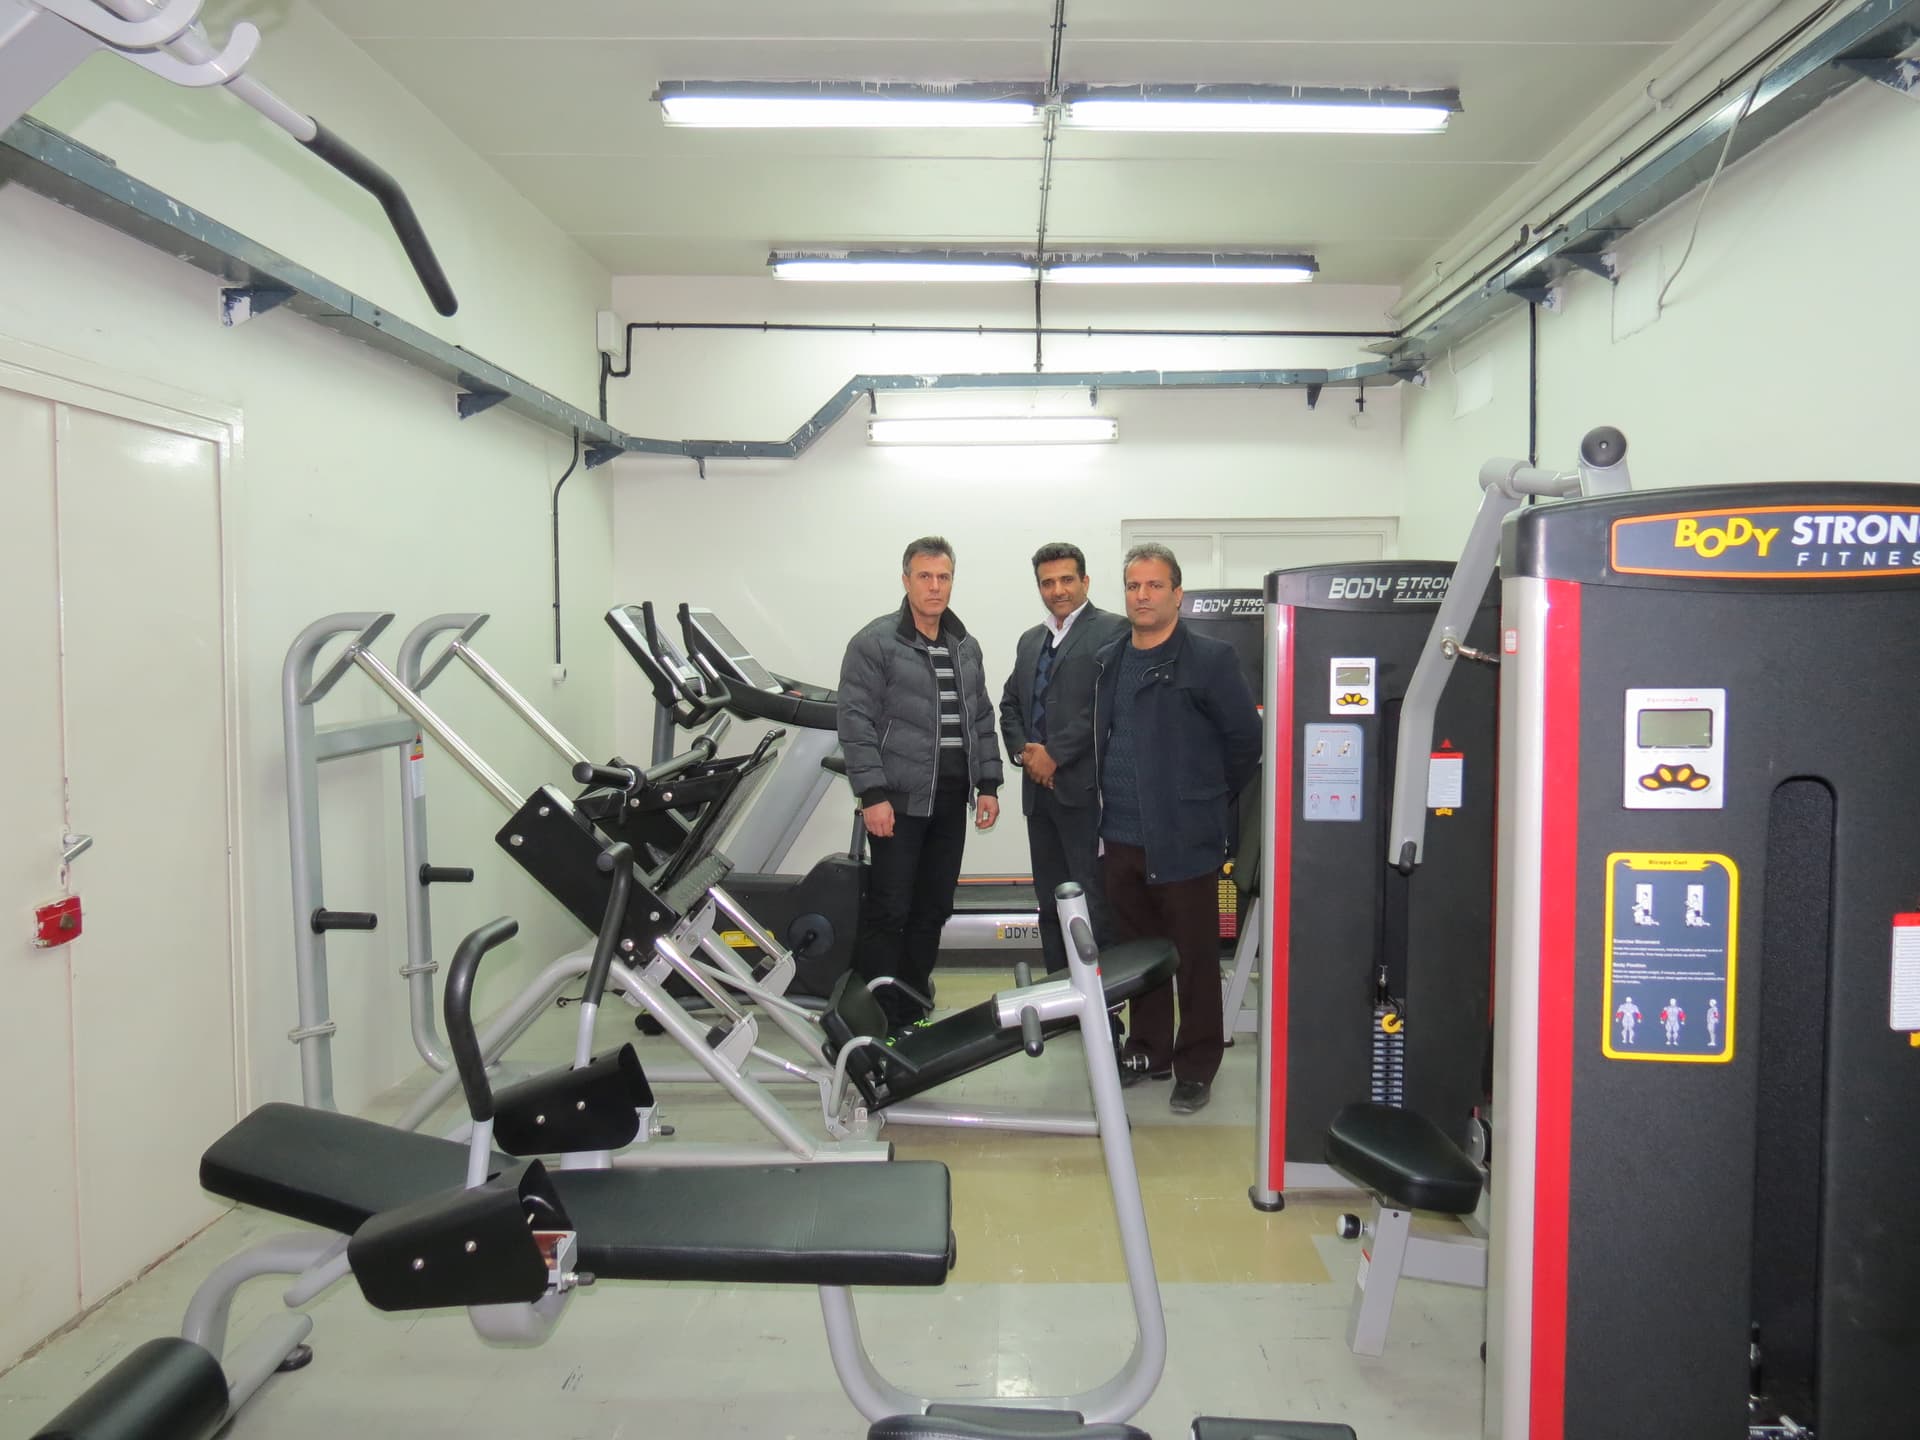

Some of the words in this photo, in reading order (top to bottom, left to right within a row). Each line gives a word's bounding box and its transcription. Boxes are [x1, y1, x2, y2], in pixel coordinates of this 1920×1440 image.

[1674, 517, 1779, 558] BODY
[1791, 515, 1920, 545] STRON
[1328, 577, 1392, 599] BODY
[1192, 599, 1231, 613] BODY
[1233, 598, 1265, 607] STRO
